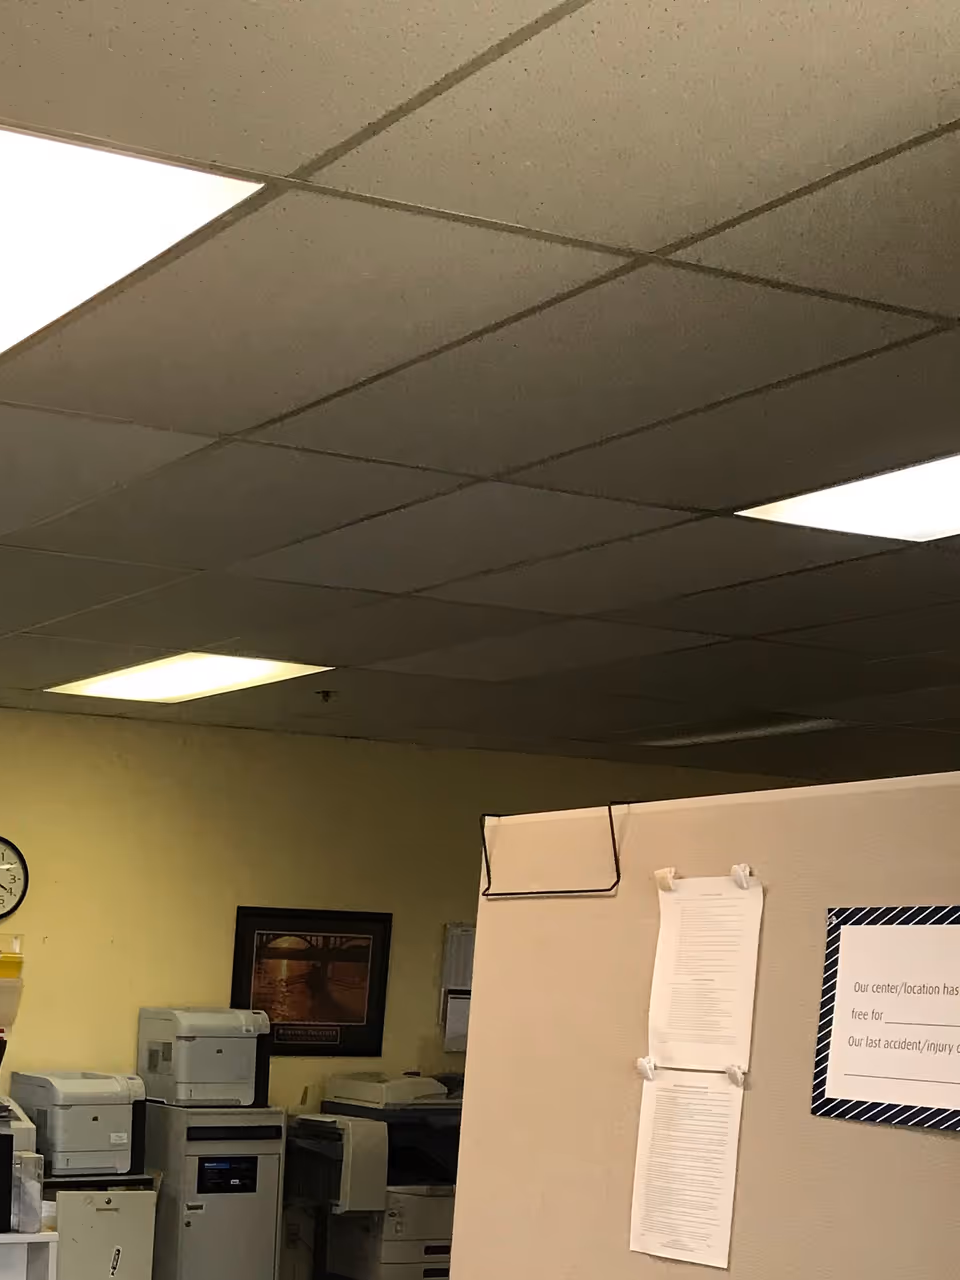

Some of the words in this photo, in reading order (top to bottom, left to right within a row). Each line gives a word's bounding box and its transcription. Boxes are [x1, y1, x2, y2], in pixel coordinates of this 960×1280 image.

[1, 852, 5, 862] 1
[8, 874, 17, 884] 3
[6, 887, 13, 896] 4
[854, 981, 869, 994] Our
[872, 982, 940, 997] center/location
[943, 983, 960, 996] has
[851, 1008, 868, 1021] free
[871, 1008, 884, 1021] for
[848, 1035, 863, 1048] Our
[865, 1036, 881, 1049] last
[883, 1037, 954, 1056] accident/injury
